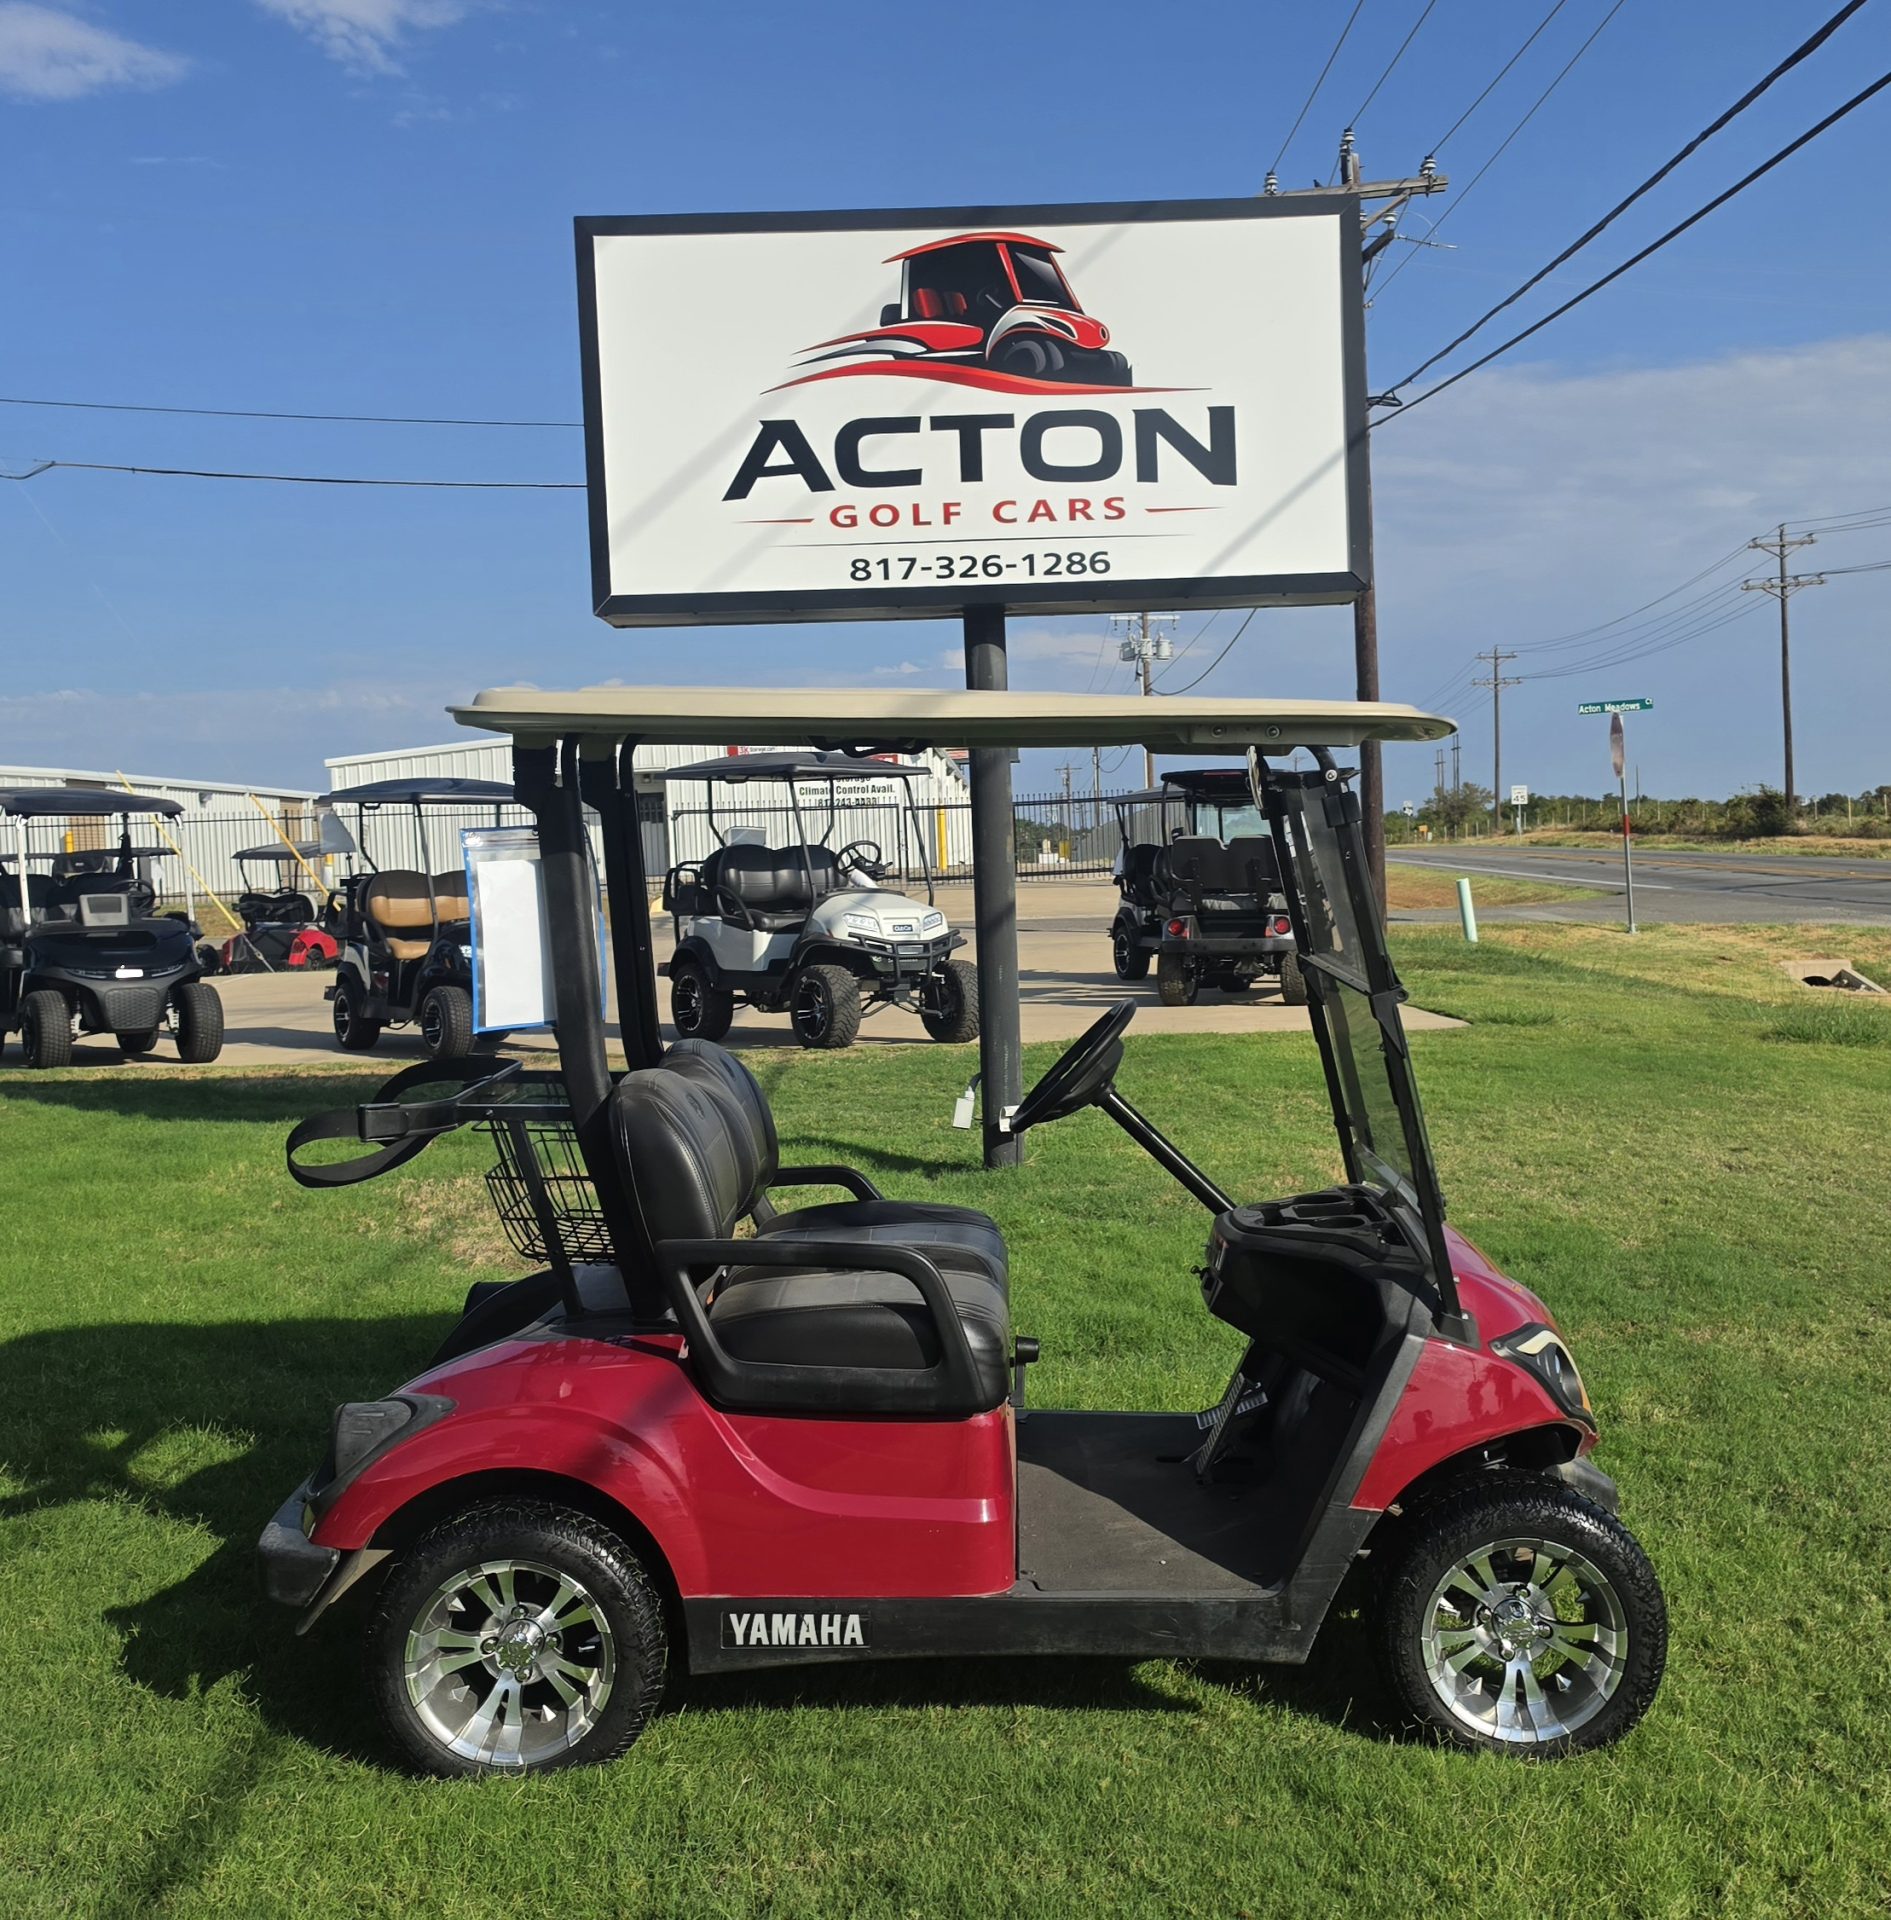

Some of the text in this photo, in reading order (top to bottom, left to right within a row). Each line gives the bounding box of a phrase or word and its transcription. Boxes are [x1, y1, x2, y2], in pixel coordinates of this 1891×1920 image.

[722, 405, 1237, 502] ACTON
[829, 497, 1127, 528] GOLF CARS
[849, 550, 1111, 582] 817-326-1286
[1579, 705, 1601, 714] Acton
[1604, 702, 1641, 713] Meadows
[799, 783, 895, 796] Climat Control Avail.
[729, 1613, 865, 1646] YAMAHA
